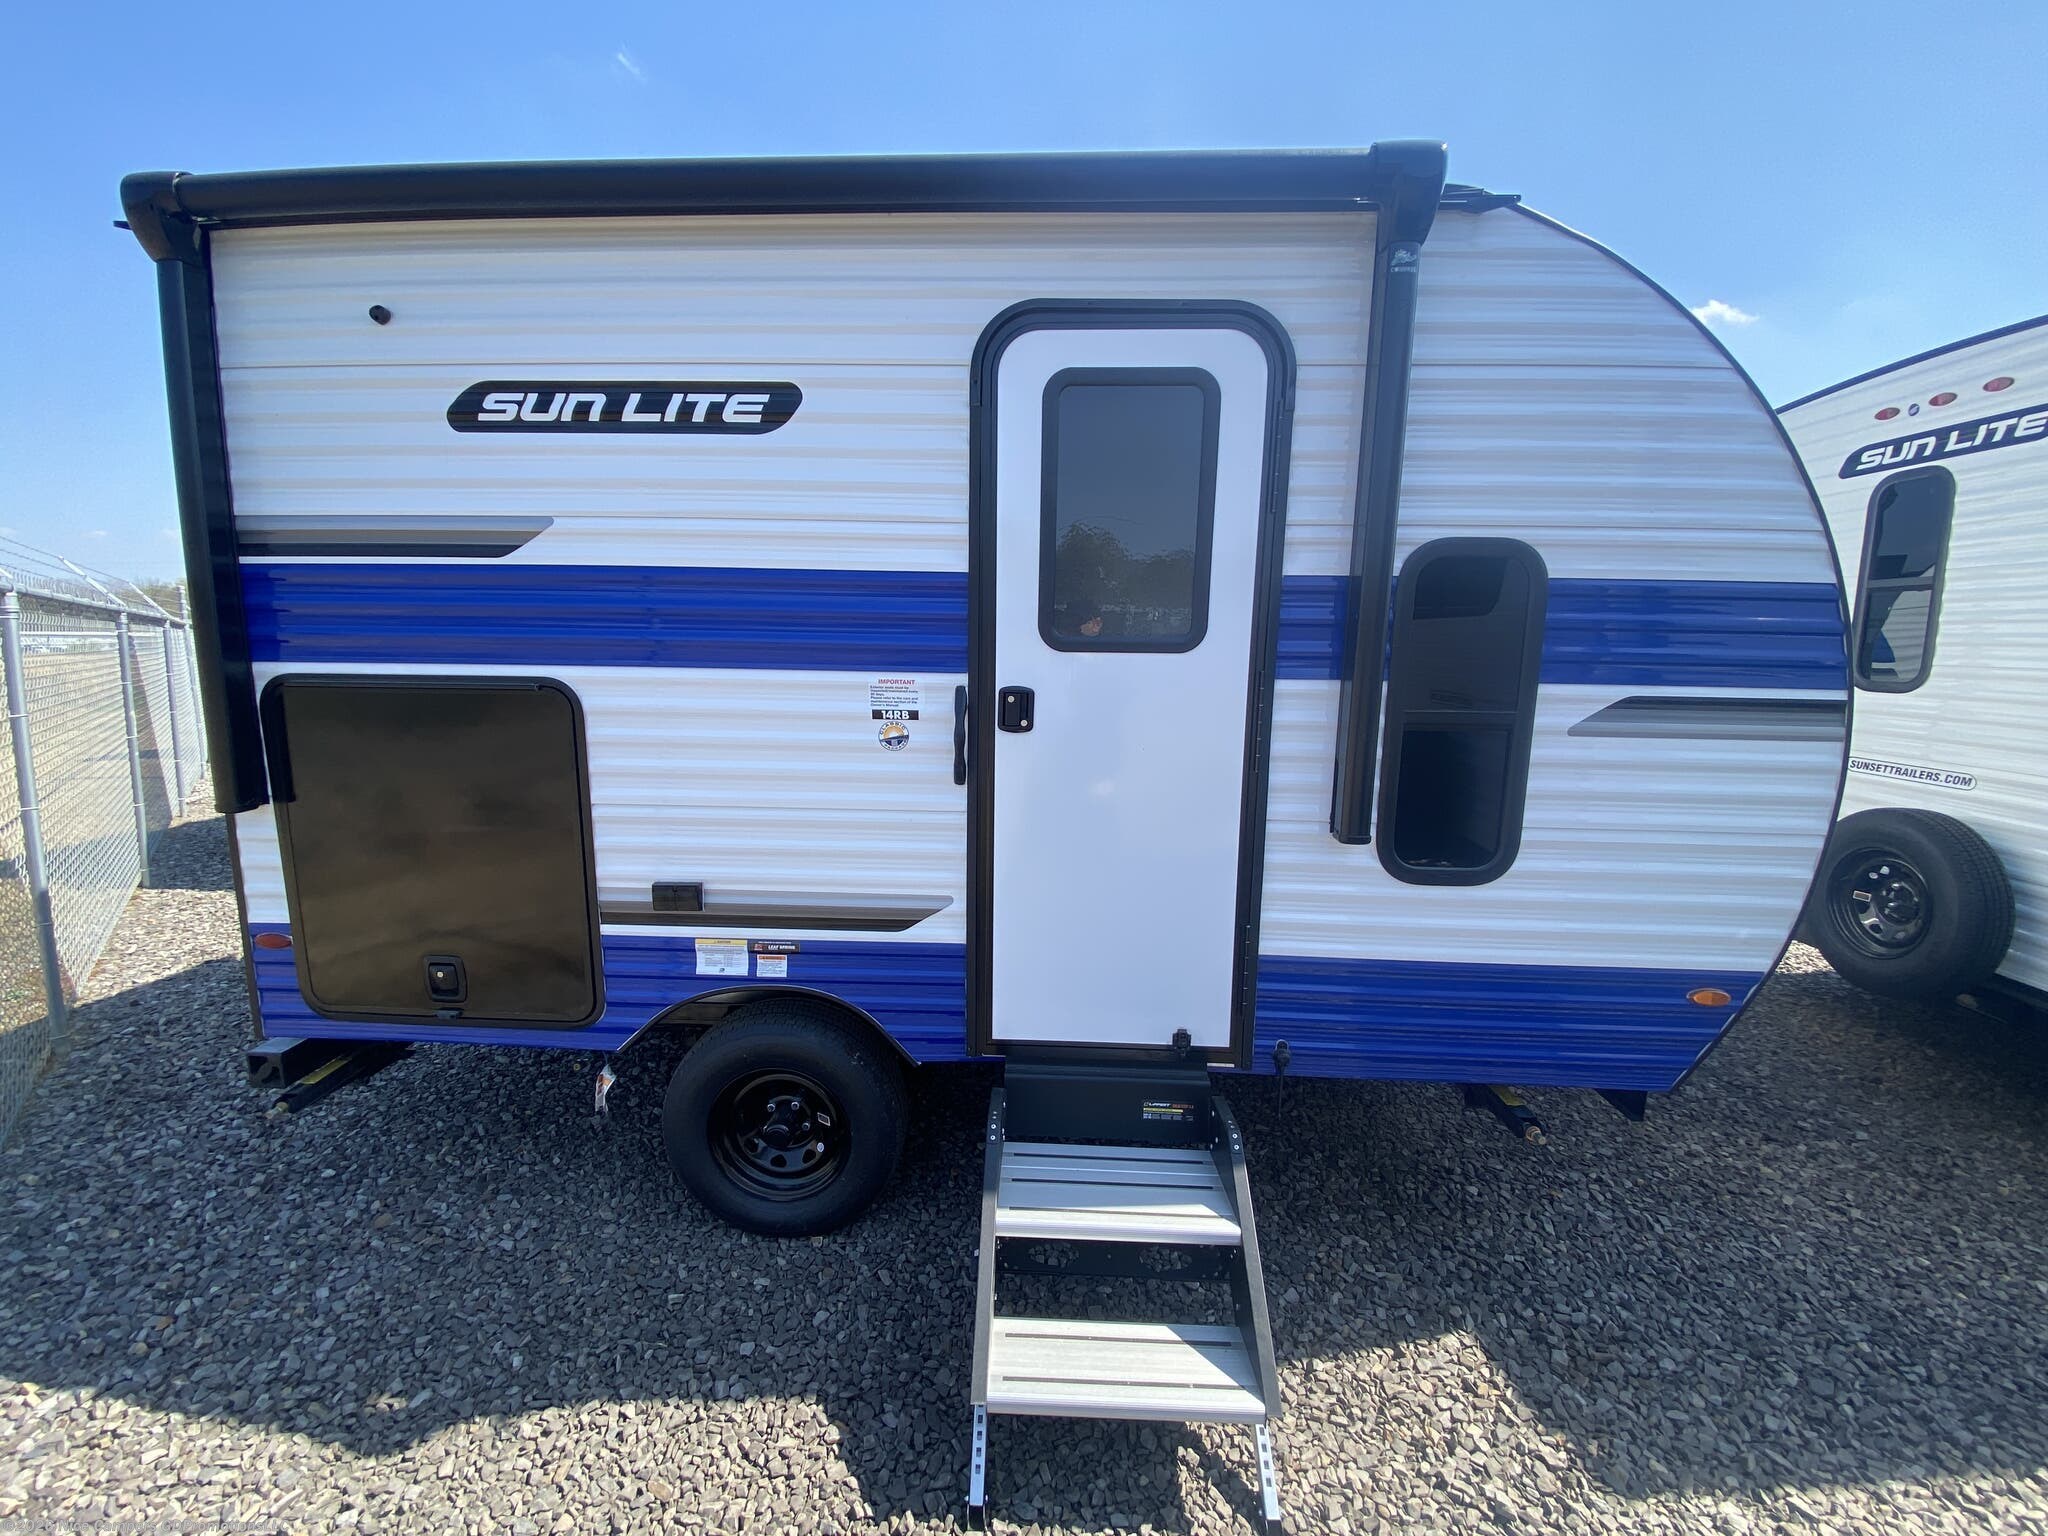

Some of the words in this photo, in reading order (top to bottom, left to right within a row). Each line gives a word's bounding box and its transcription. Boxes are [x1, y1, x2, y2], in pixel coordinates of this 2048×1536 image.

[477, 392, 607, 422] SUN
[621, 393, 771, 423] LITE
[1855, 436, 1936, 471] SUN
[1944, 413, 2048, 452] LITE
[881, 710, 910, 720] 14RB
[1849, 759, 1973, 787] SUNSETTRAILERS.COM
